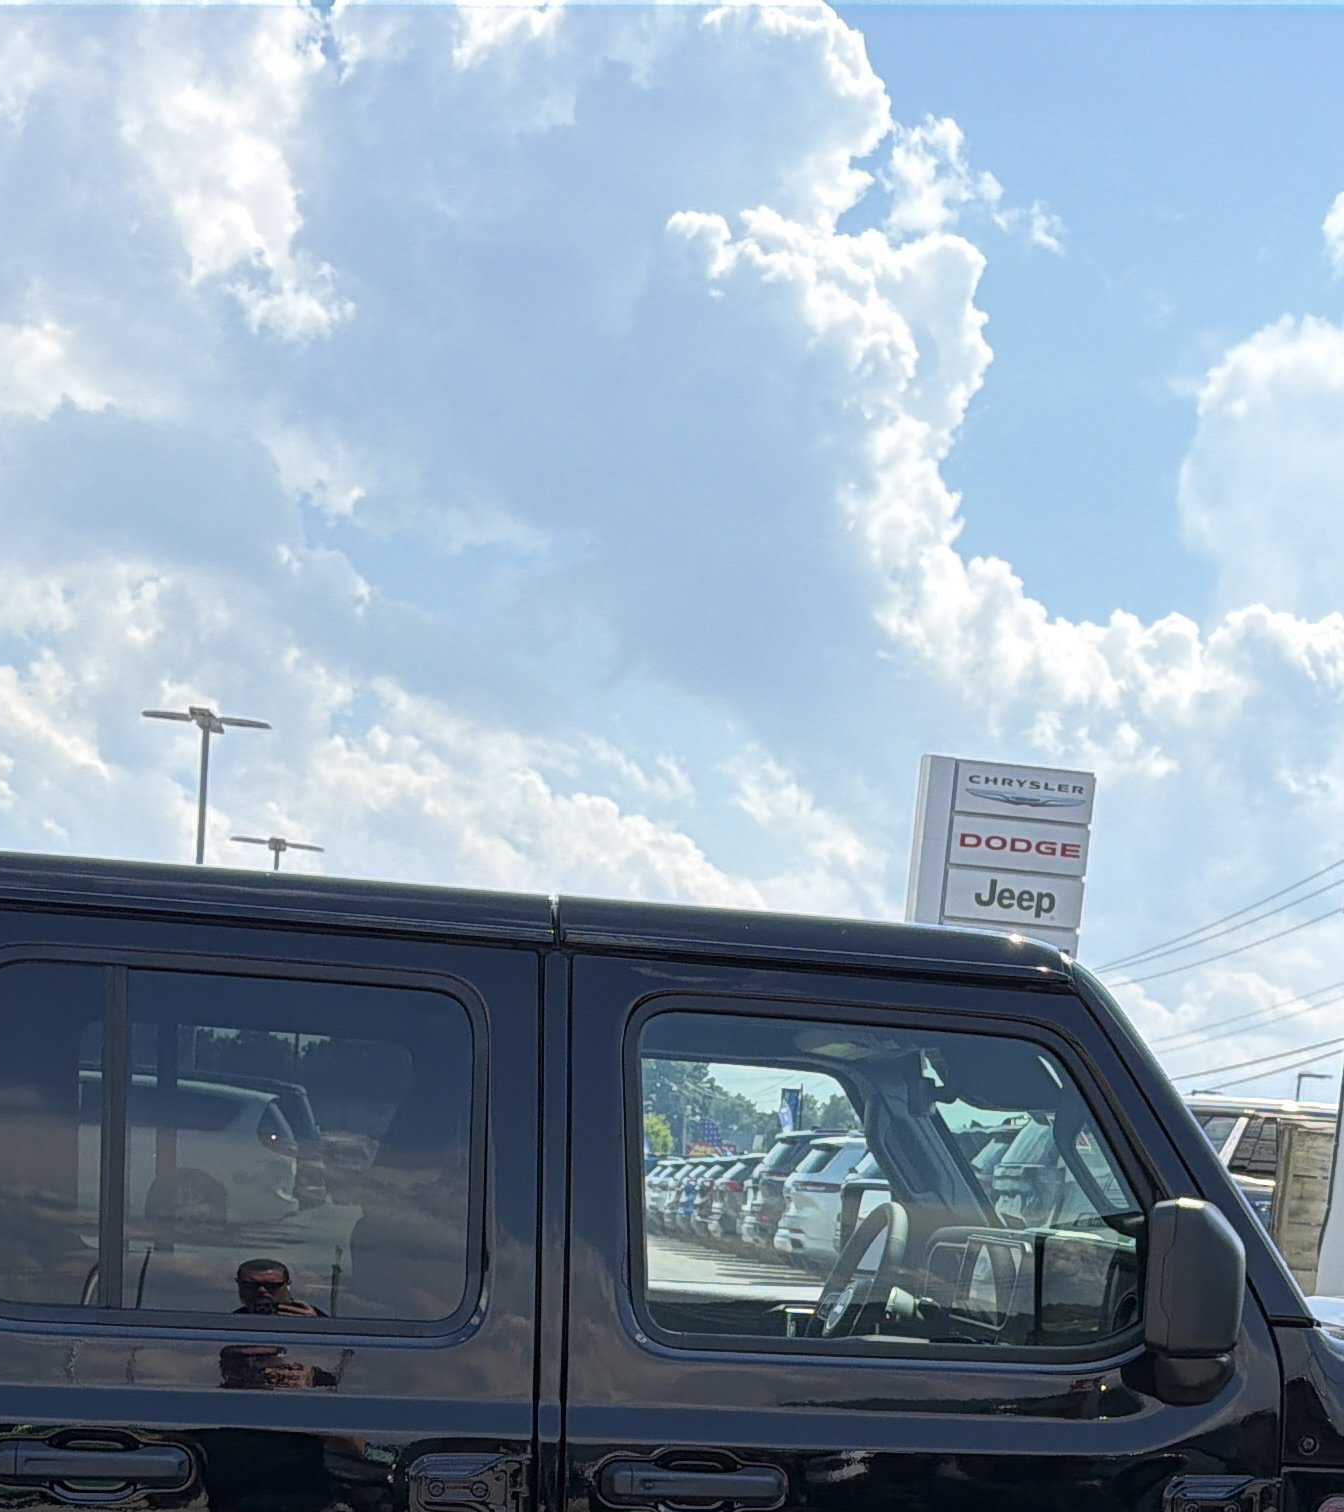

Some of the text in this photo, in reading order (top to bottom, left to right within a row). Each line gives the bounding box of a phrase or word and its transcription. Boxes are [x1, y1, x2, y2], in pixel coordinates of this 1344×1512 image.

[968, 774, 1084, 795] CHRYSLER
[960, 832, 1081, 858] DODGE
[974, 879, 1056, 918] Jeep
